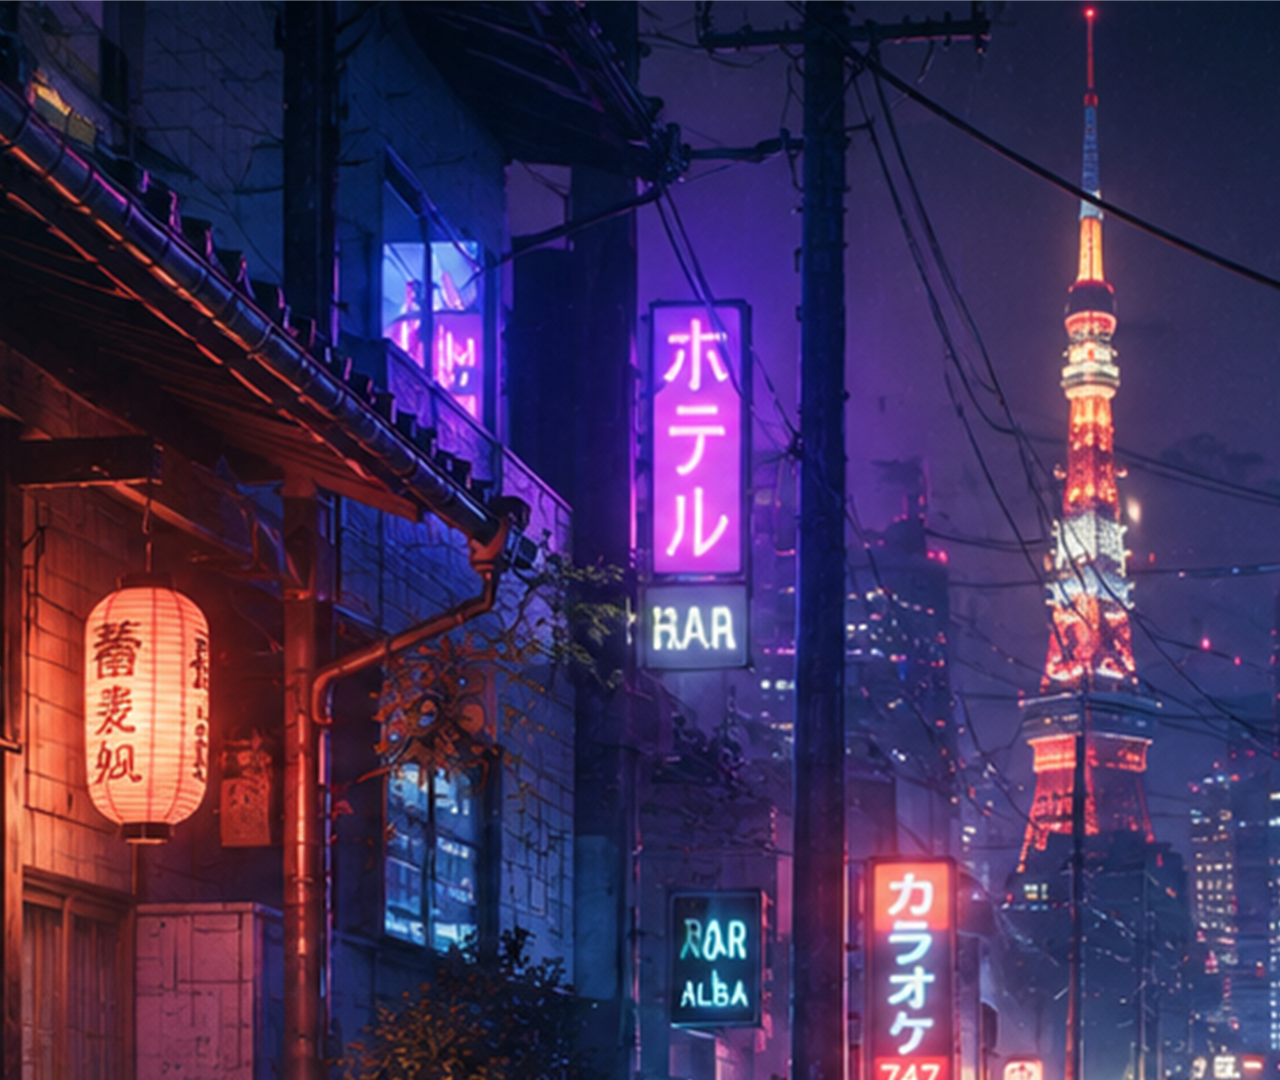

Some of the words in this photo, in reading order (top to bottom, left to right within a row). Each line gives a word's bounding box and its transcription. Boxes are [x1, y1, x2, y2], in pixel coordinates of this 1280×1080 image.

[663, 318, 729, 558] ホテル
[887, 871, 937, 1056] カラオケ
